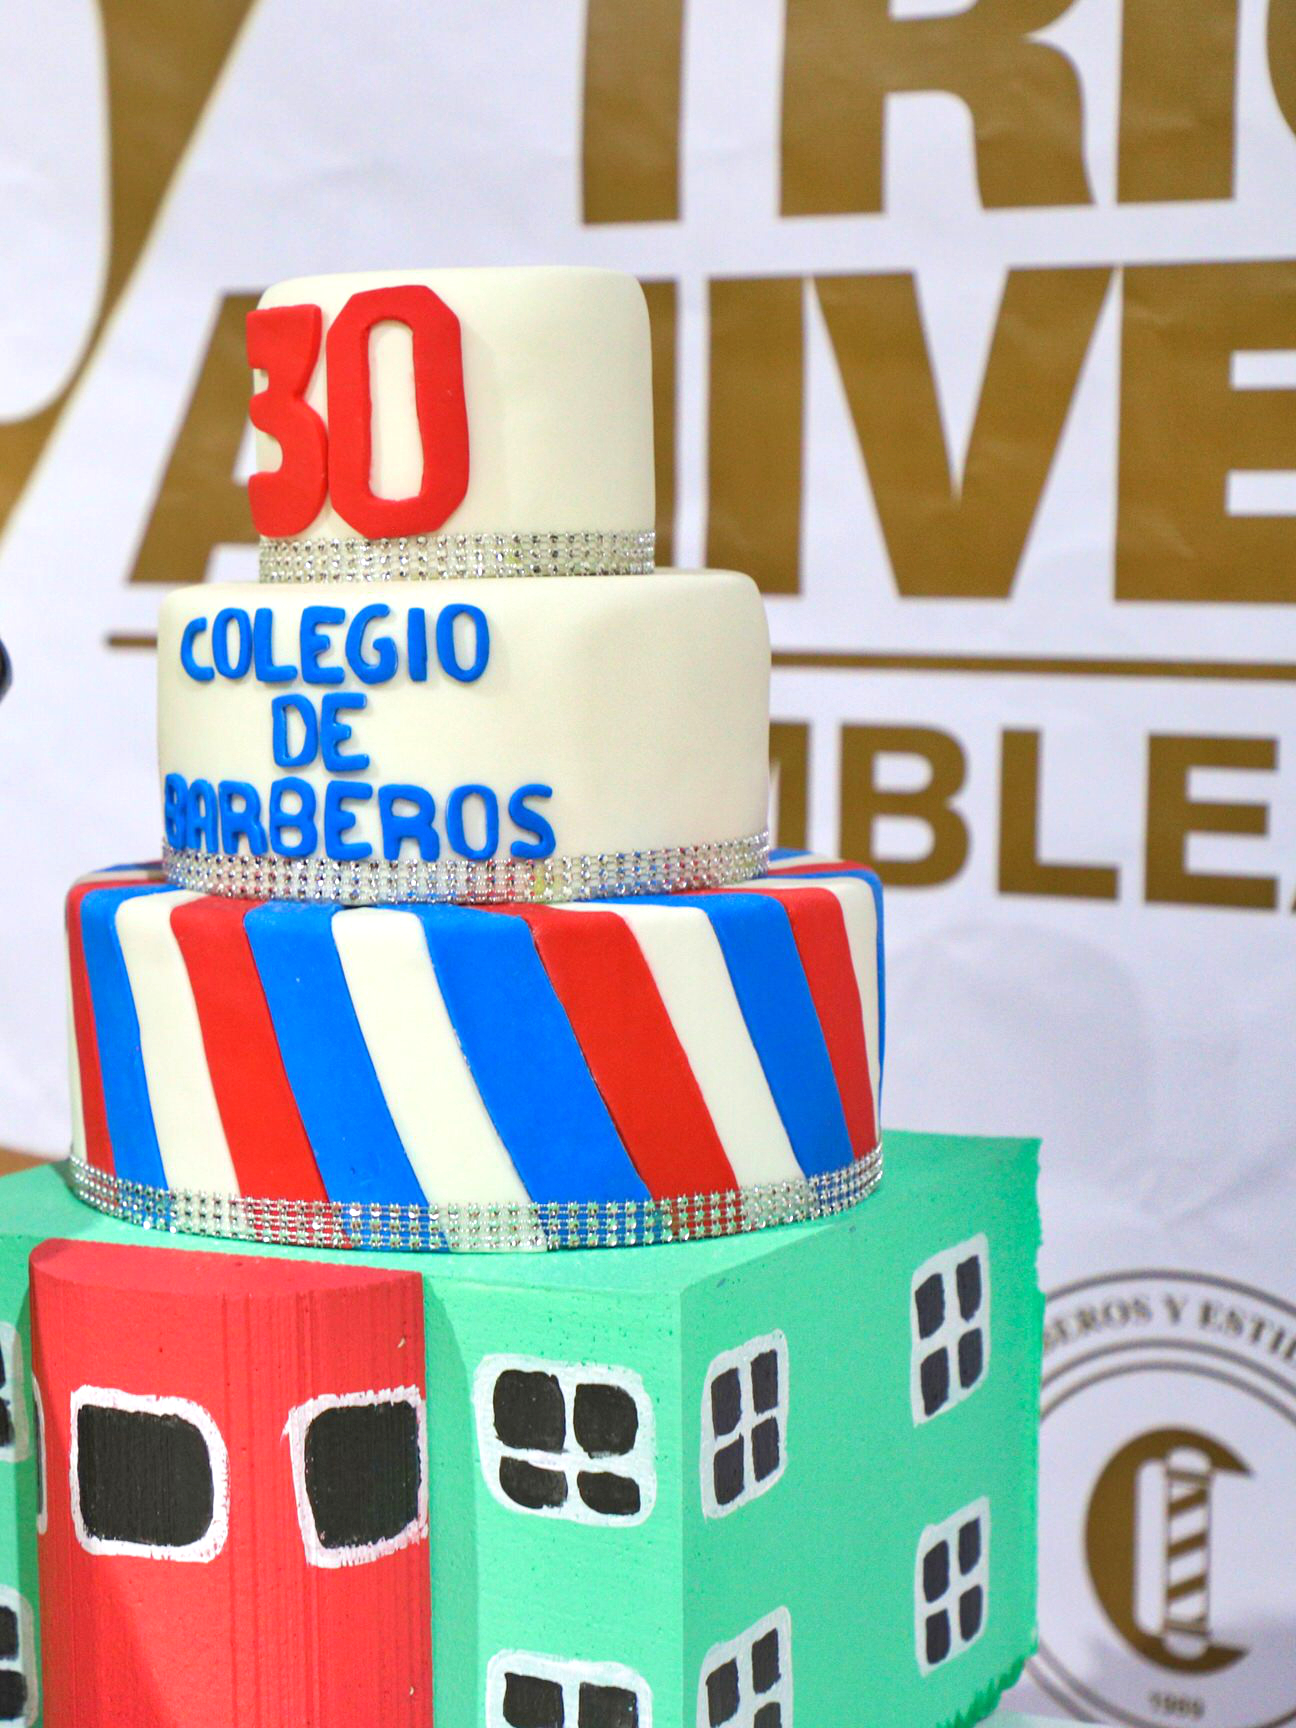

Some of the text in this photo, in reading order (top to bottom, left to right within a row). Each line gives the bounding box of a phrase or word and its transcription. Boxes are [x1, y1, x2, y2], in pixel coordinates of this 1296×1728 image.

[580, 0, 1296, 226] RI
[246, 284, 470, 539] 30
[180, 603, 491, 685] COLEGIO
[271, 692, 371, 772] DE
[164, 773, 557, 862] BARBEROS
[770, 716, 1296, 912] BLE
[1044, 1295, 1153, 1352] EROS
[1162, 1292, 1189, 1325] Y
